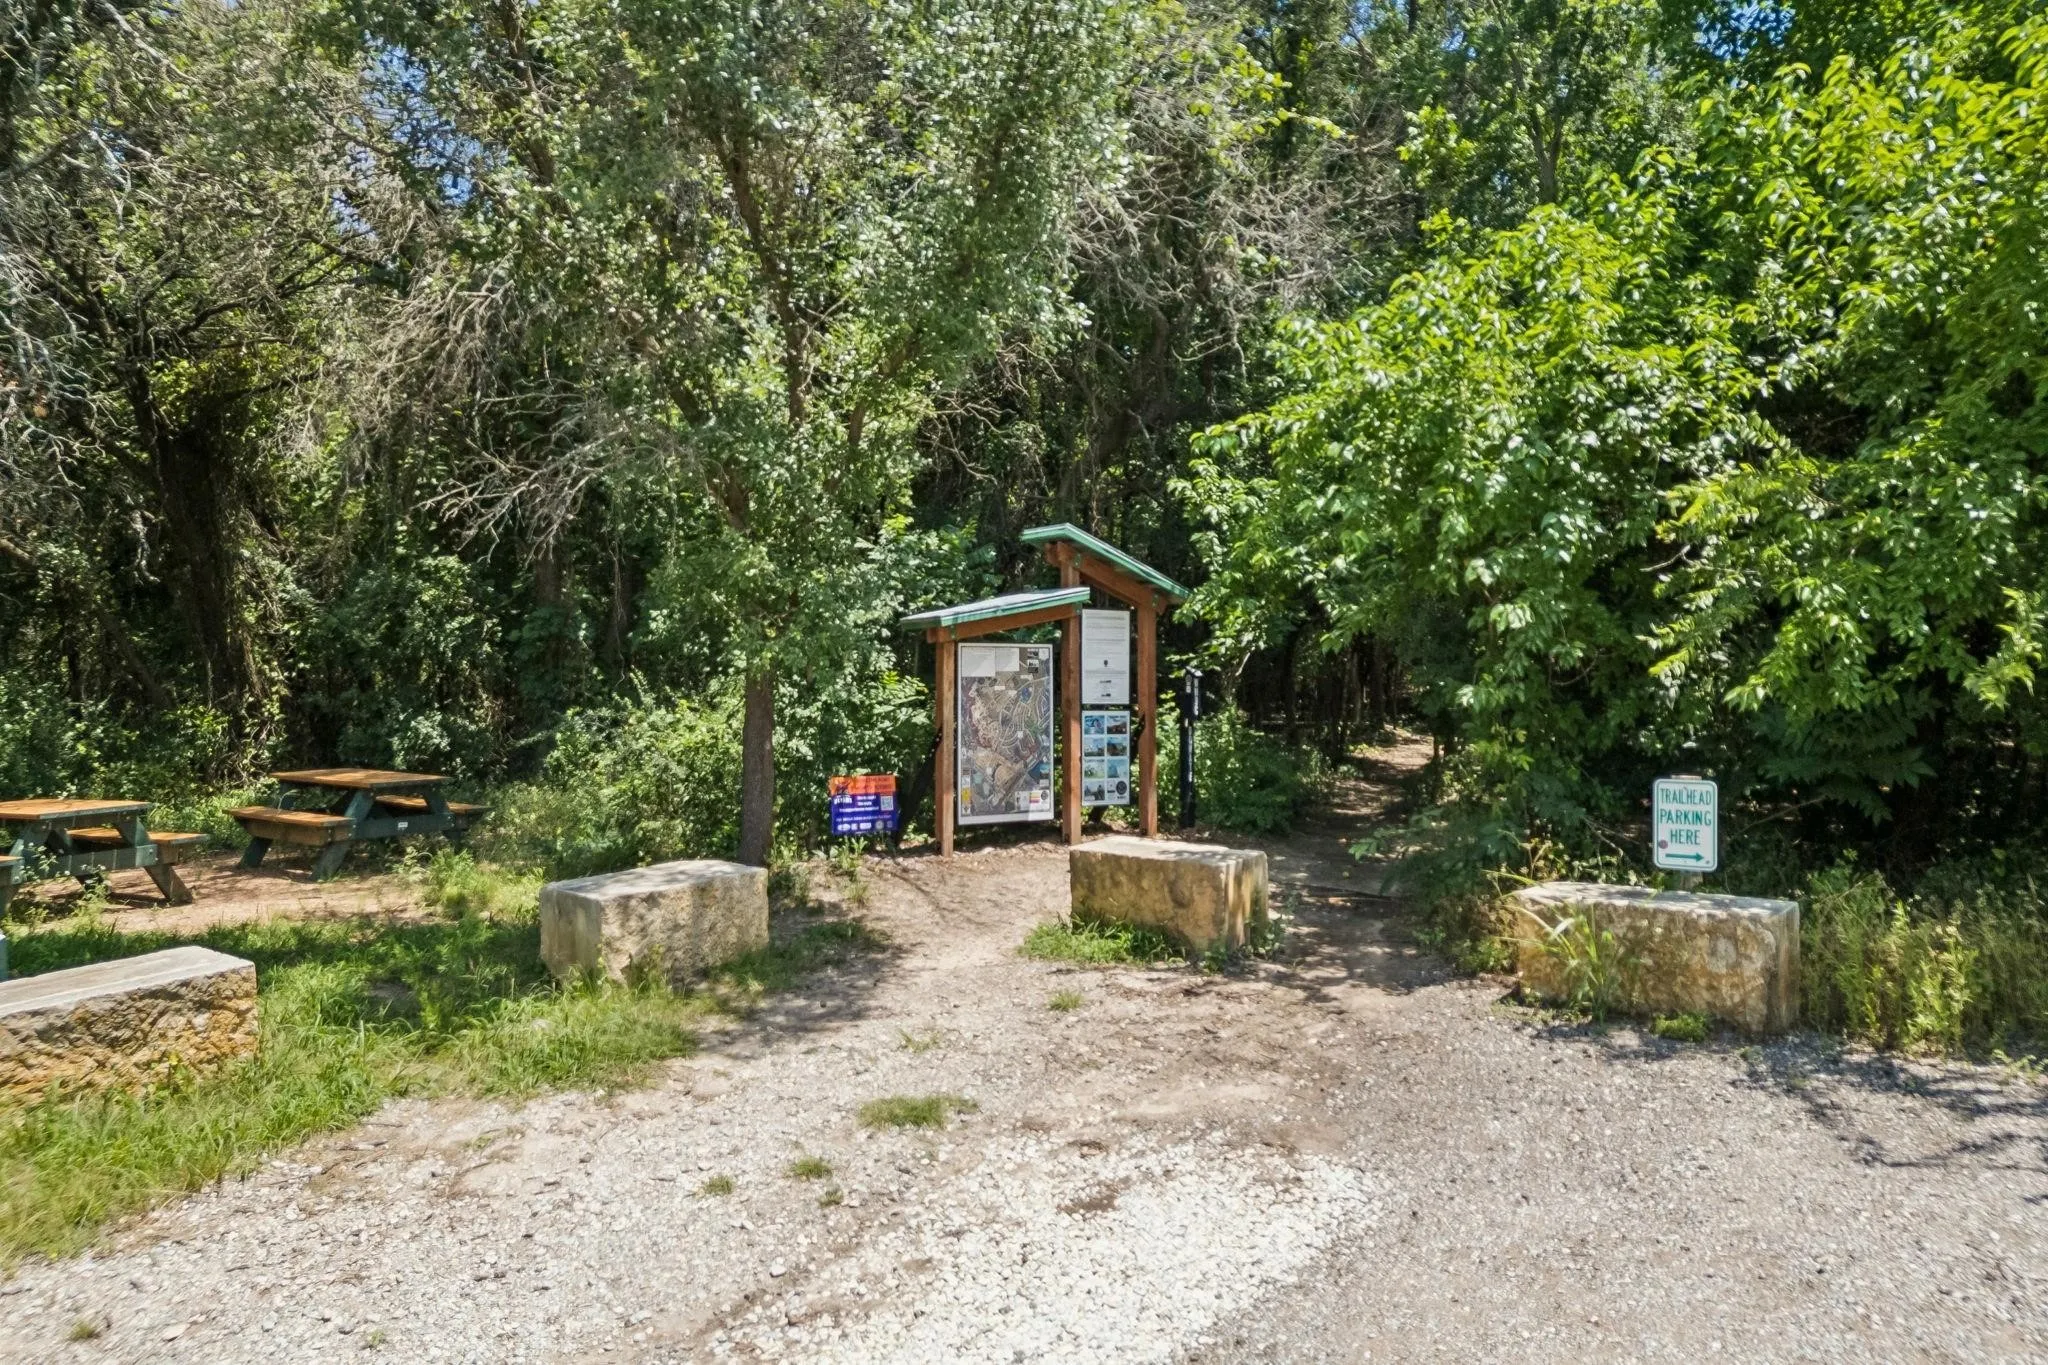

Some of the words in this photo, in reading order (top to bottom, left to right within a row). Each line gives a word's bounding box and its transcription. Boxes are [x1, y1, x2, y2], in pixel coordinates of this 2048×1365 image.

[1660, 788, 1712, 806] TRAILHEAD
[1660, 808, 1712, 826] PARKING
[1670, 829, 1701, 845] HERE
